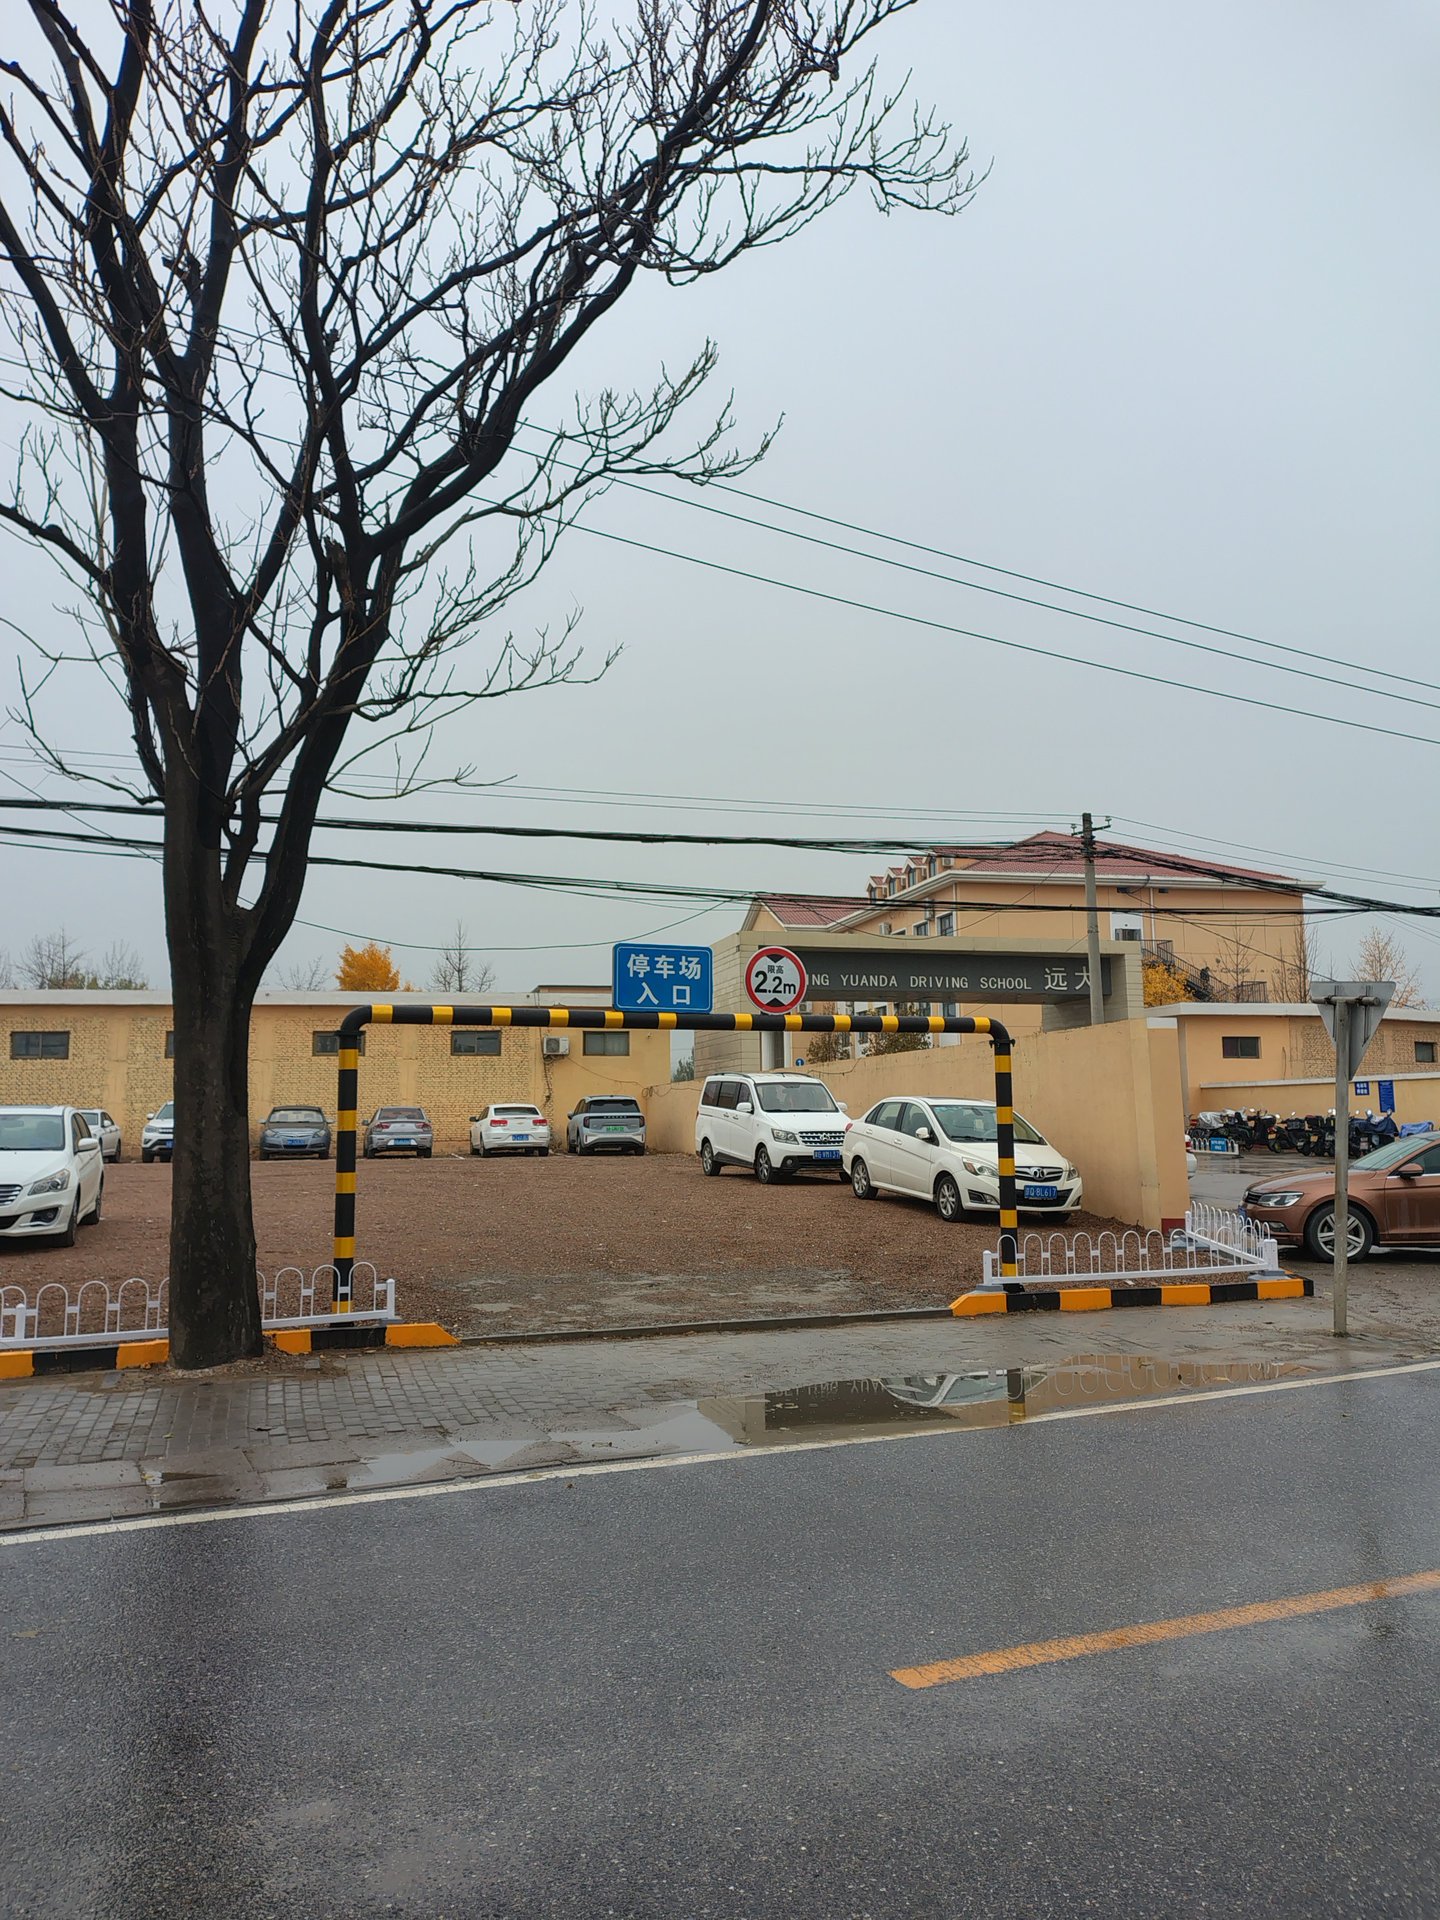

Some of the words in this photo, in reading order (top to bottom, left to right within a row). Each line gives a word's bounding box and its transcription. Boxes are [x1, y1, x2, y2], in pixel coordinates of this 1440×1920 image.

[627, 954, 701, 980] 停车场
[767, 964, 784, 974] 限高
[1044, 966, 1092, 991] 远大
[636, 982, 691, 1005] 入口
[754, 970, 797, 994] 2.2m
[840, 974, 898, 987] YUANDA
[910, 975, 969, 989] DRIVING
[980, 977, 1032, 990] SCHOOL
